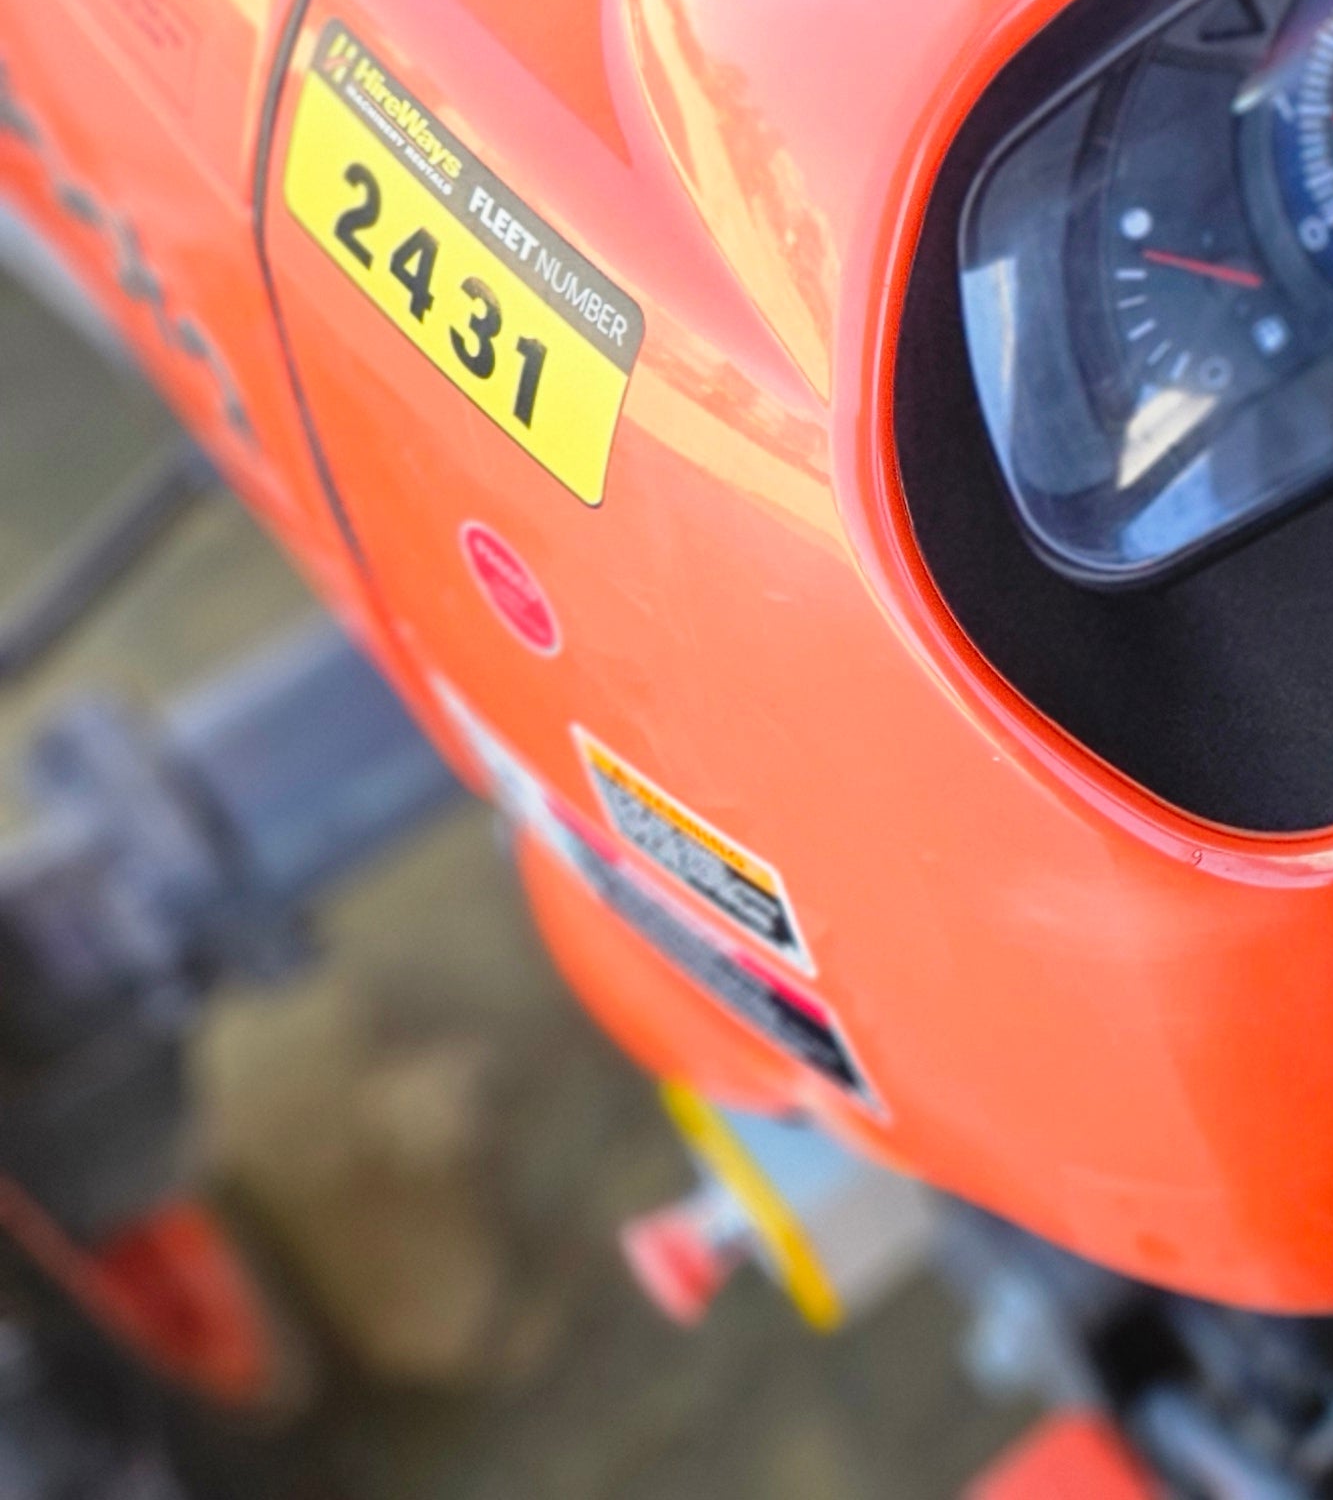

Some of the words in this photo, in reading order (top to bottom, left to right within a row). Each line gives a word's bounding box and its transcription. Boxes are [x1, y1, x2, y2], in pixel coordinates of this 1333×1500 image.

[353, 58, 463, 178] HireWays
[334, 162, 548, 430] 2431
[469, 186, 540, 261] FLEET
[534, 248, 628, 347] NUMBER
